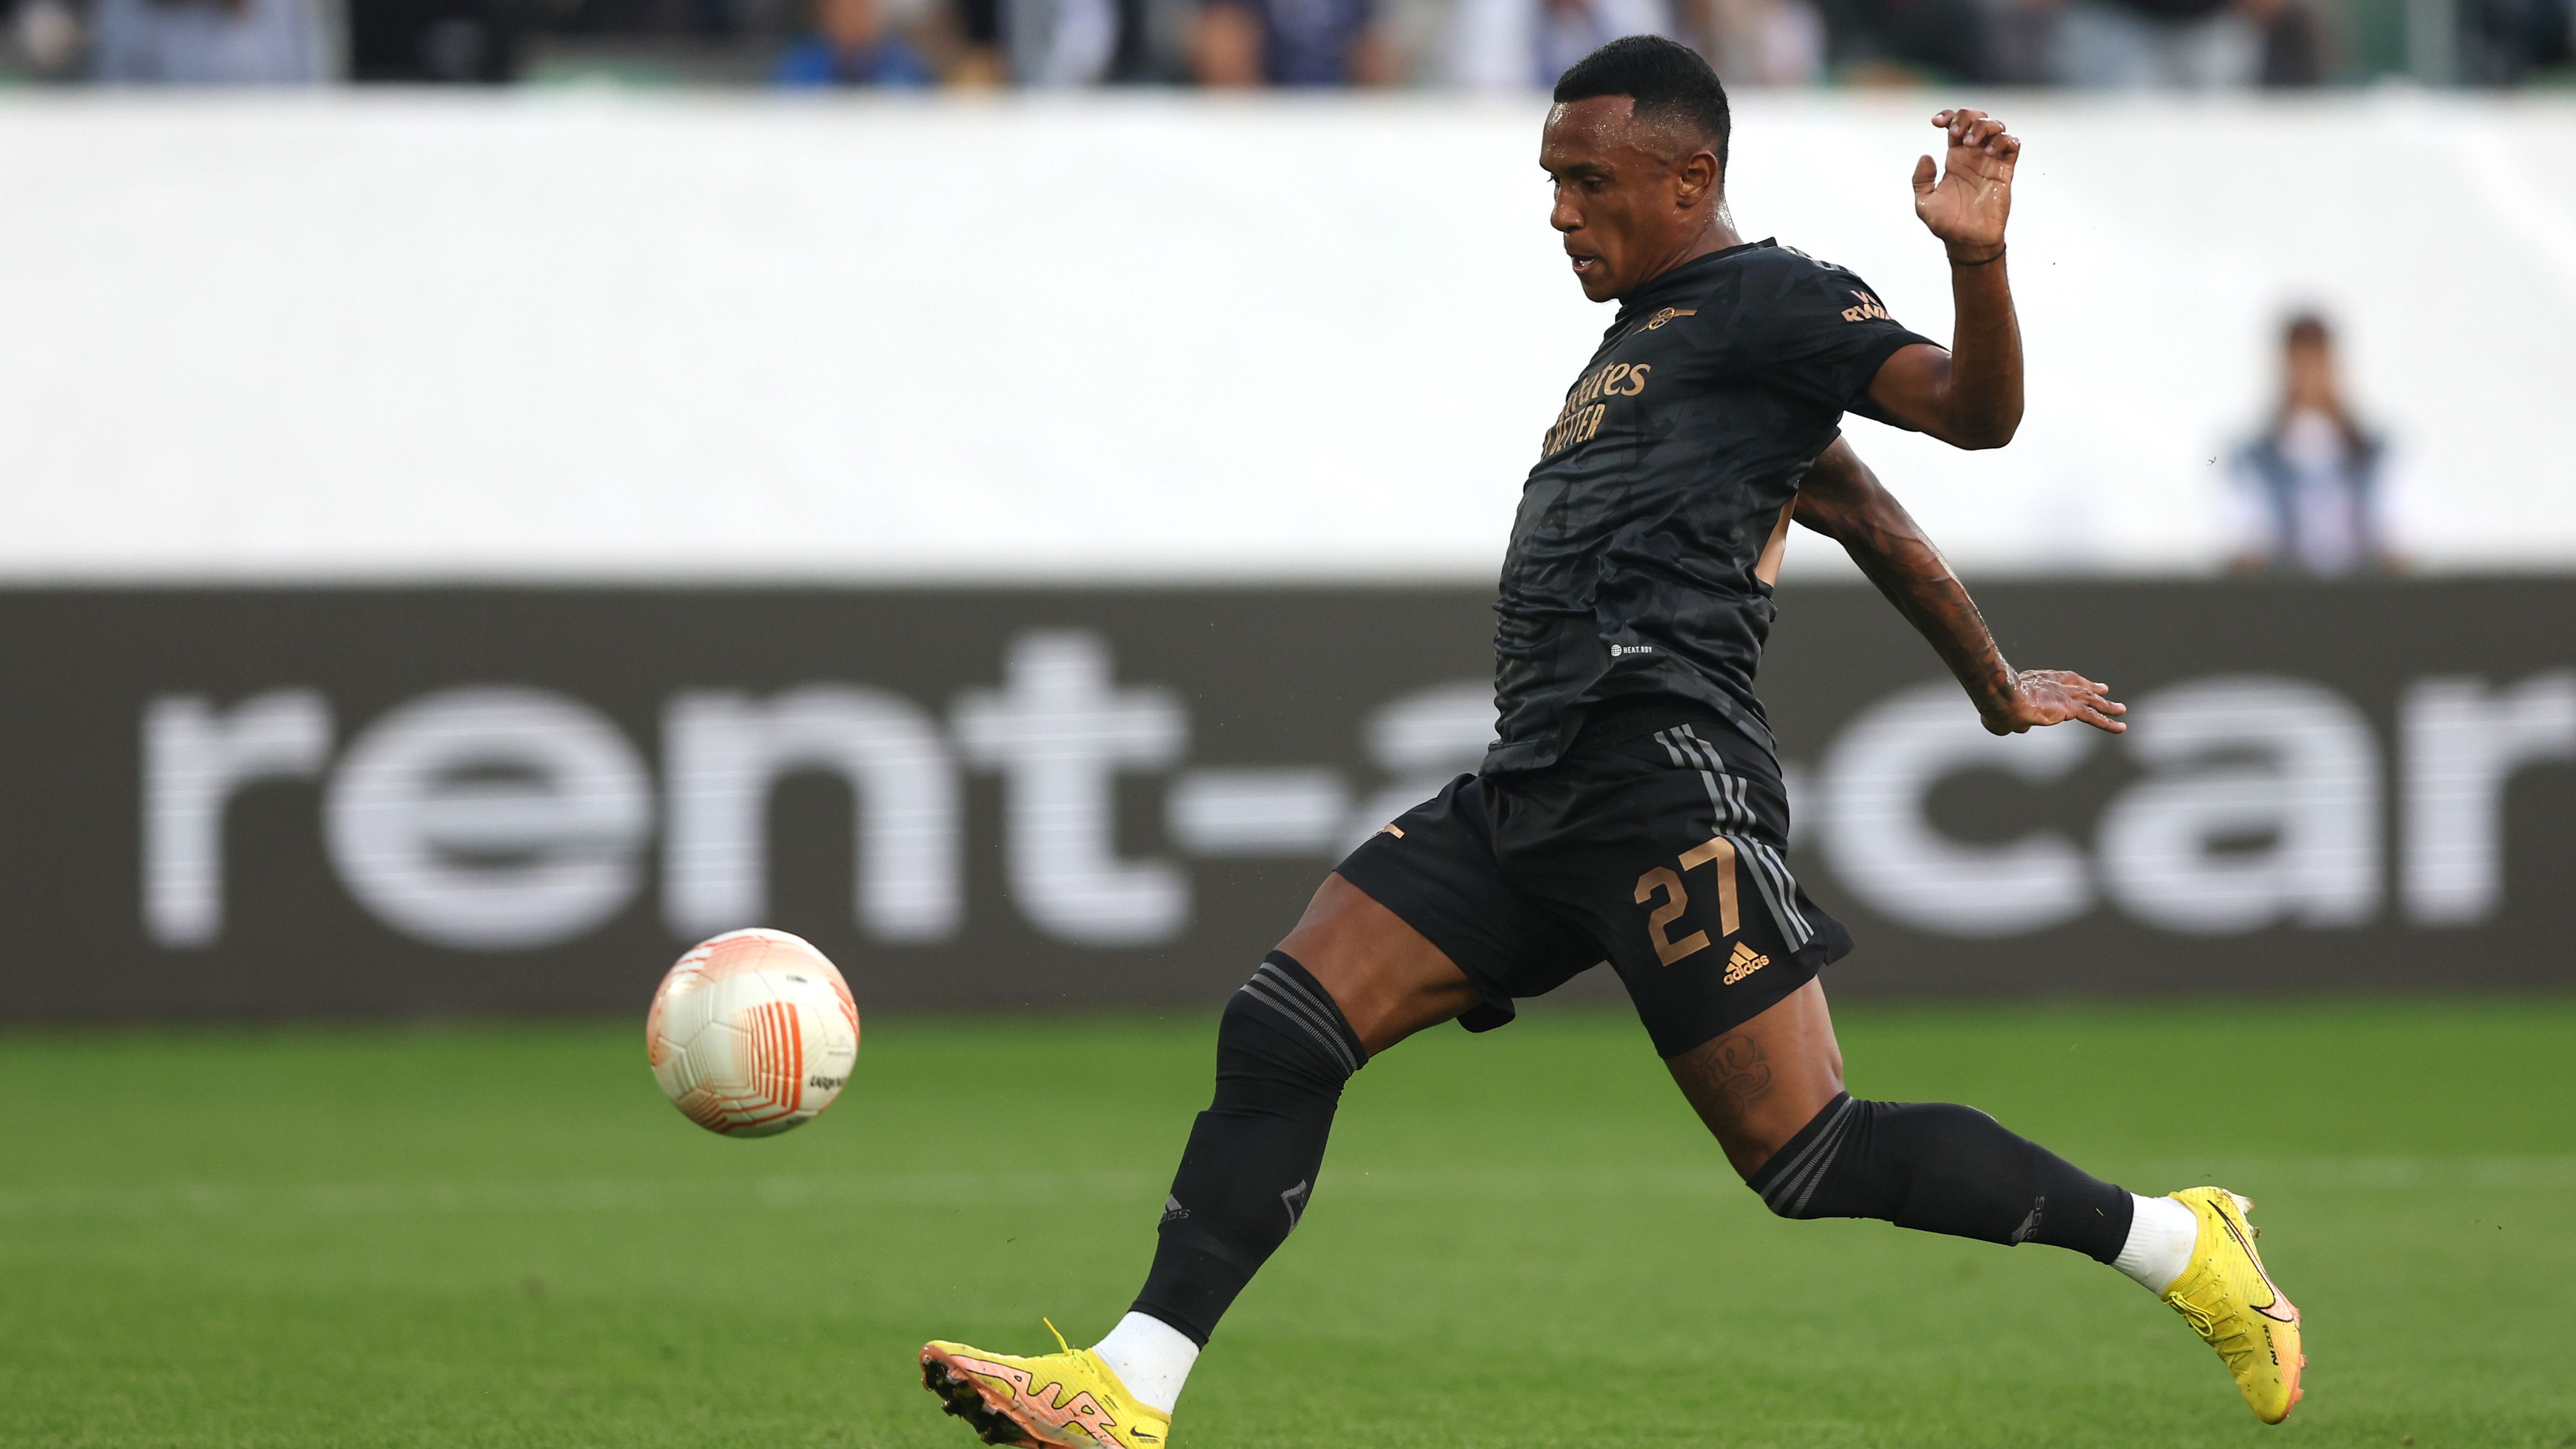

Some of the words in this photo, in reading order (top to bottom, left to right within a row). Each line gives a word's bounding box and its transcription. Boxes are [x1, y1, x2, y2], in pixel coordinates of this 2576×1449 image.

[1623, 646, 1652, 654] HEAT.RDY
[1634, 836, 1740, 967] 27
[1723, 955, 1770, 985] adidas
